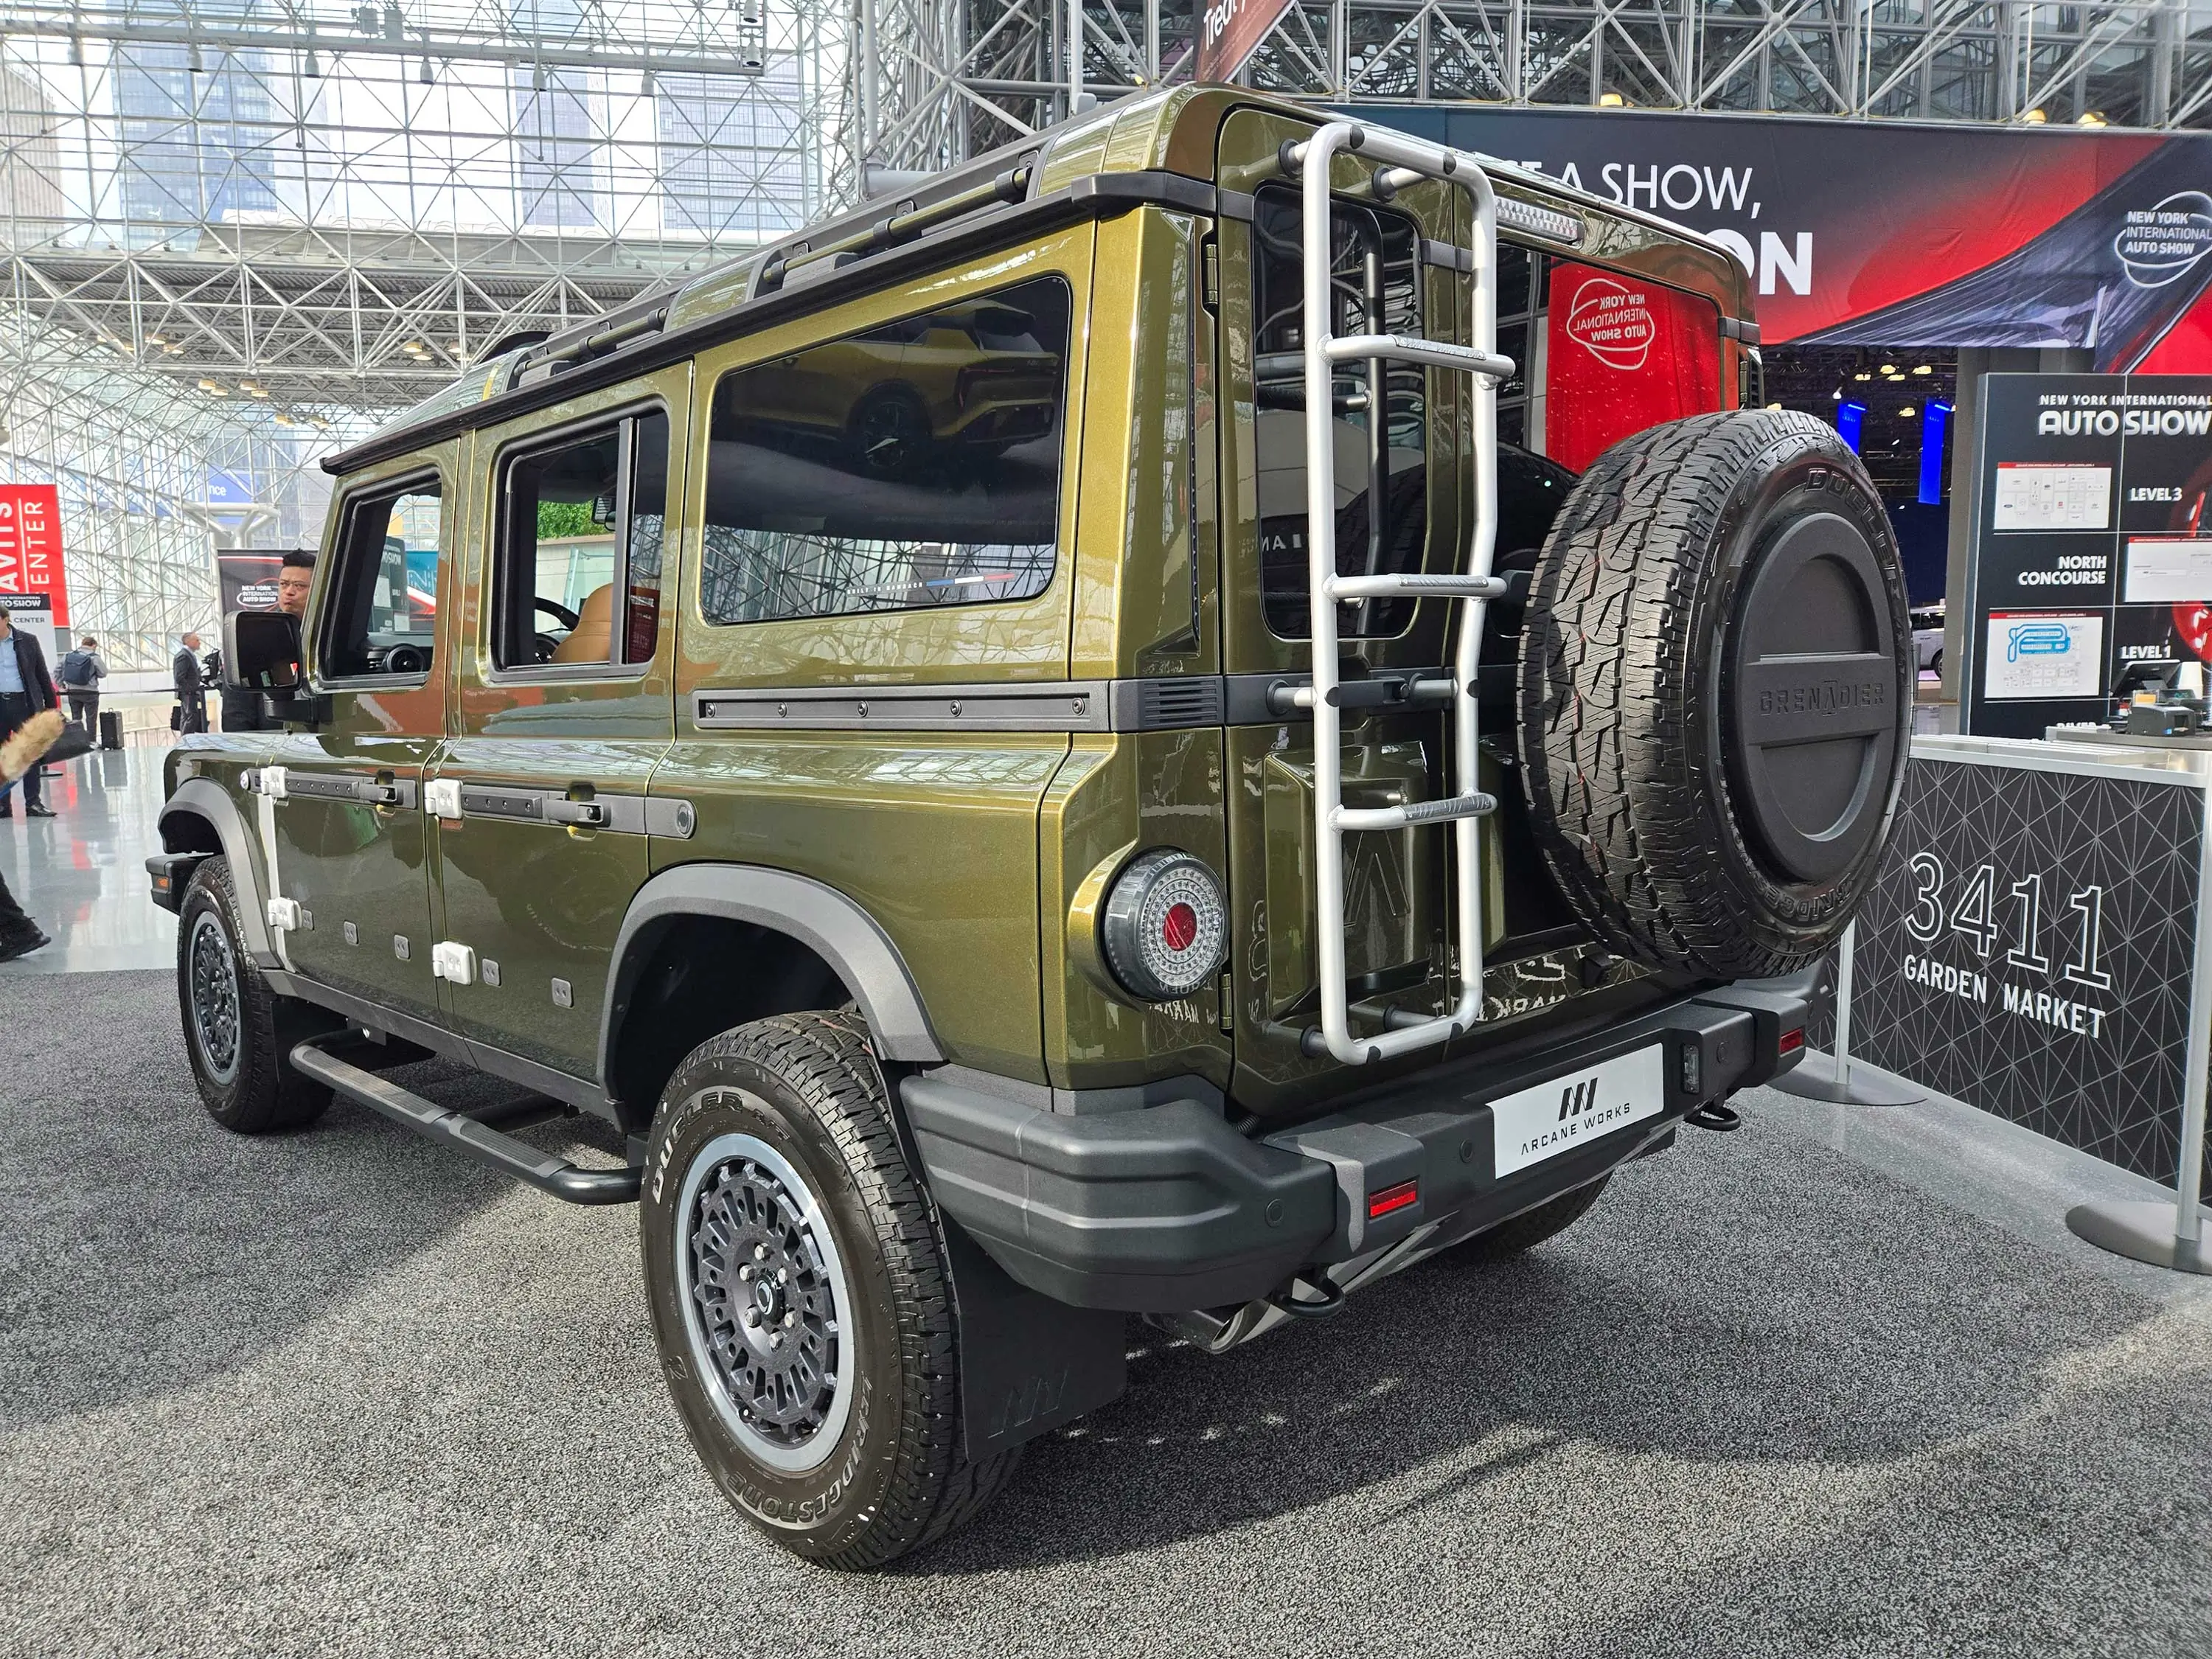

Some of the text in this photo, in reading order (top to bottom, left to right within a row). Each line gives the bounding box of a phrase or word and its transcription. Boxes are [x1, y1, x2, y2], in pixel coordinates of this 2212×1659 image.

[1601, 162, 1761, 219] SHOW,
[2126, 211, 2188, 224] NEW YORK
[2126, 226, 2212, 240] INTERNATIONAL
[2124, 241, 2195, 254] AUTO SHOW
[2039, 395, 2212, 406] NEW YORK INTERNATIONAL
[2038, 410, 2212, 436] AUTO SHOW
[2129, 487, 2183, 501] LEVEL 3
[24, 501, 50, 594] ENTER
[2058, 556, 2107, 570] NORTH
[2018, 571, 2107, 585] CONCOURSE
[13, 599, 41, 608] SHOW
[2119, 644, 2171, 659] LEVEL 1
[1759, 681, 1885, 717] GRENADIER
[1905, 852, 2111, 990] 3411
[1904, 954, 2106, 1039] GARDEN MARKET
[1521, 1103, 1631, 1156] ARCANE WORKS
[652, 1091, 743, 1206] DUELER
